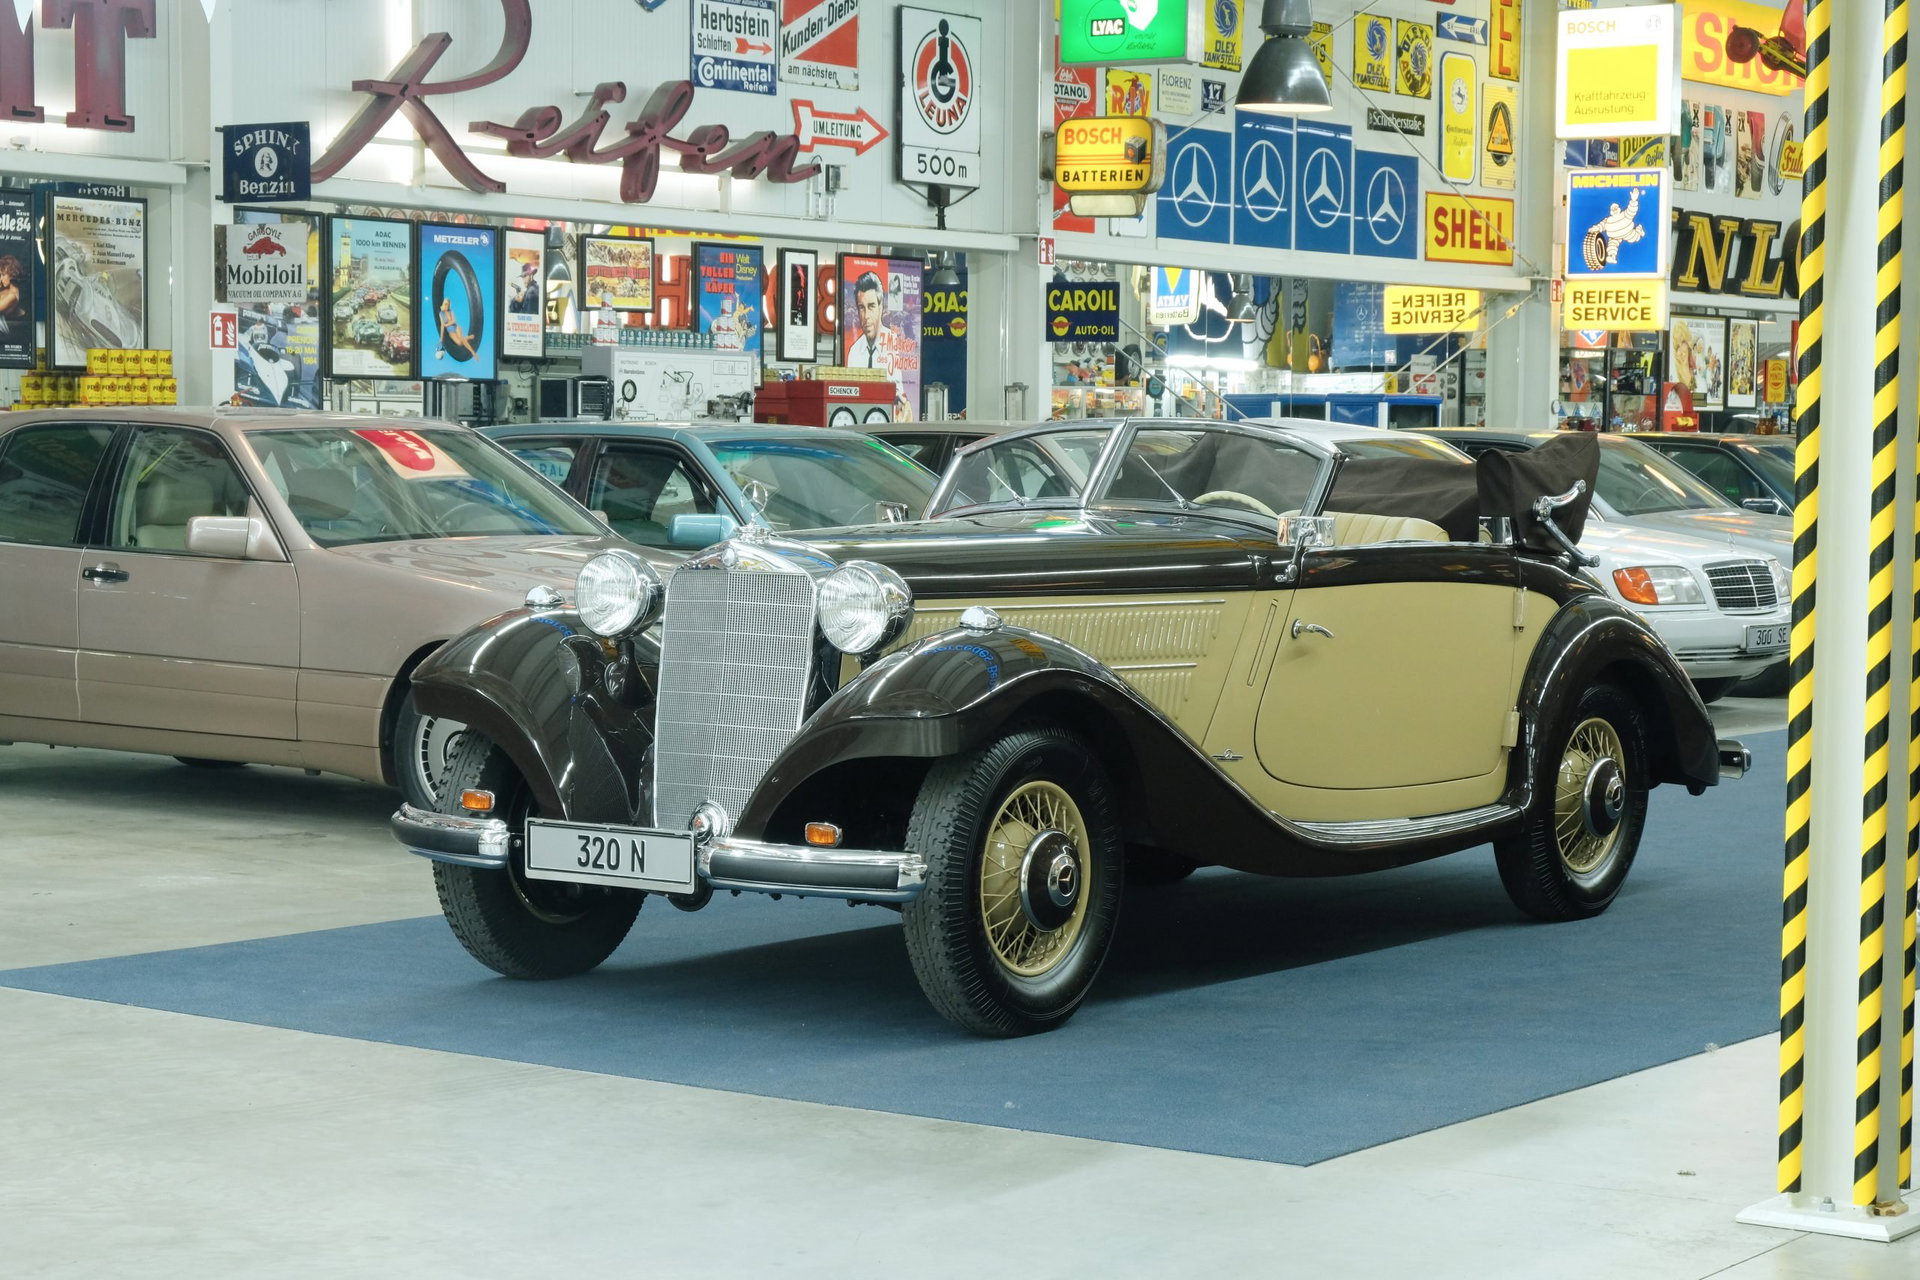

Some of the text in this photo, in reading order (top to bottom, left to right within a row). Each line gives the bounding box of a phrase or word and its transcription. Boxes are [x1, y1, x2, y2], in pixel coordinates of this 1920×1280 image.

[700, 4, 770, 38] Herbstein
[1091, 18, 1125, 36] LYAC
[1567, 20, 1616, 35] BOSCH
[697, 33, 732, 52] Schlotten
[1214, 39, 1237, 54] OLEX
[1204, 51, 1242, 66] TANKSTELLE
[697, 56, 772, 87] Continental
[787, 64, 838, 81] am nächsten
[743, 80, 769, 93] Reifen
[1162, 74, 1192, 90] FLORENZ
[1208, 83, 1222, 100] 17
[918, 89, 968, 128] LEUNA
[812, 120, 862, 139] UMLEITUNG
[1064, 127, 1122, 145] BOSCH
[917, 153, 967, 179] 500 m
[1062, 169, 1144, 182] BATTERIEN
[1572, 174, 1658, 188] MICHELIN
[239, 176, 296, 195] Benzin
[56, 213, 142, 227] MERCEDES-BENZ
[375, 231, 391, 239] ADAC
[1434, 206, 1507, 251] SHELL
[355, 239, 407, 249] 1000 km RENNEN
[433, 234, 479, 246] METZELER
[735, 253, 750, 263] Walt
[227, 263, 302, 285] Mobiloil
[700, 265, 735, 279] TOLLER
[735, 264, 757, 276] Disney
[228, 290, 252, 298] VACUUM
[252, 290, 262, 298] OIL
[262, 290, 291, 298] COMPANY
[705, 279, 735, 295] KÄFER
[1048, 289, 1117, 312] CAROIL
[1573, 290, 1651, 304] REIFEN-
[1572, 307, 1651, 321] SERVICE
[1074, 325, 1115, 335] AUTO-OIL
[829, 387, 853, 395] SCHENCK
[1756, 627, 1788, 646] 300 SE
[577, 834, 646, 874] 320 N
